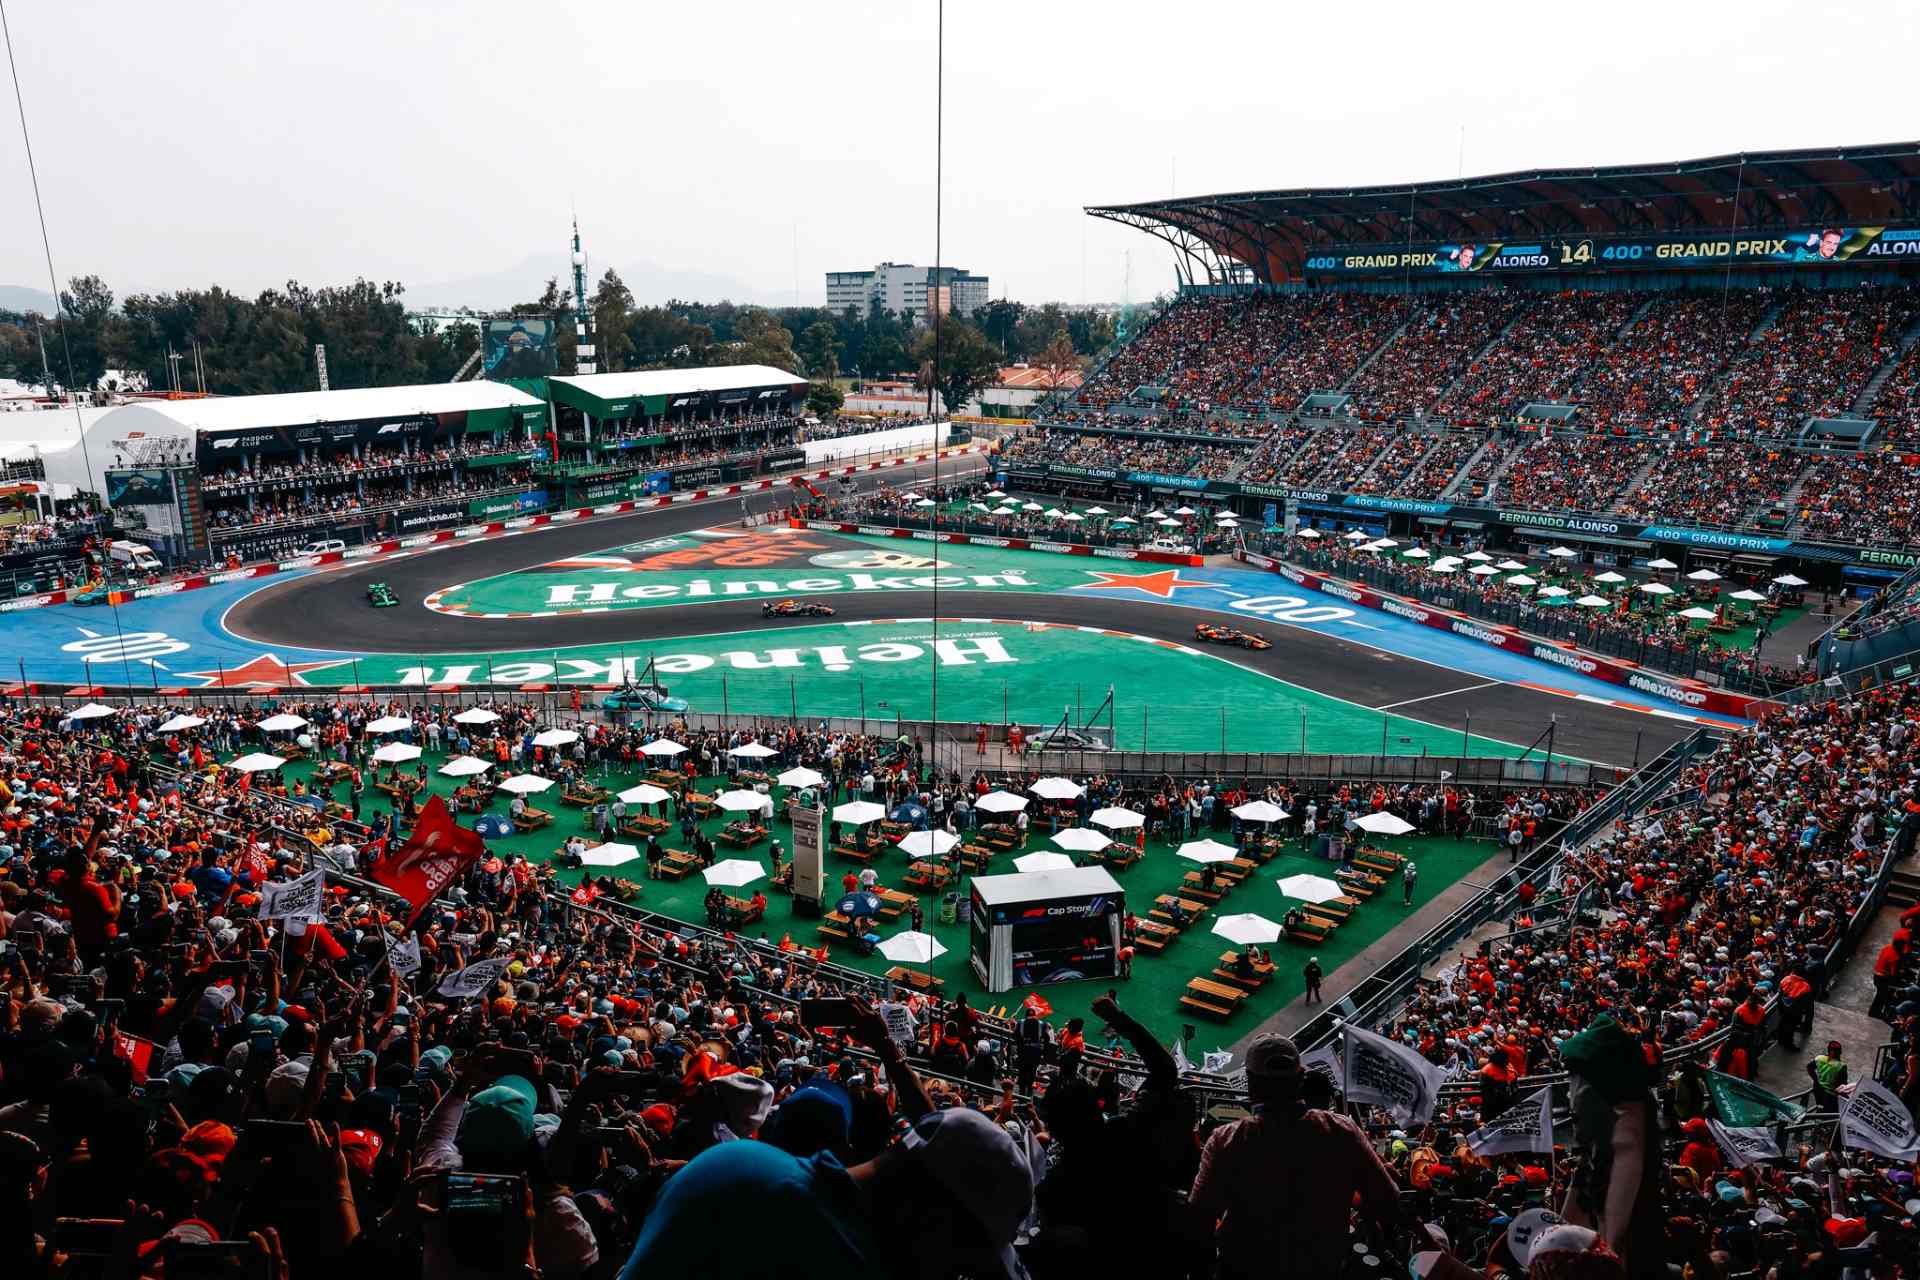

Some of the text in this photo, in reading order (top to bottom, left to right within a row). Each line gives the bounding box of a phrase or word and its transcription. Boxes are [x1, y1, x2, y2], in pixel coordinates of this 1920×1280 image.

[1561, 244, 1590, 262] 14
[1656, 242, 1730, 258] GRAND
[1735, 239, 1787, 255] PRIX
[1345, 255, 1398, 268] GRAND
[1401, 252, 1437, 266] PRIX
[1493, 255, 1549, 268] ALONSO
[1049, 464, 1117, 479] FERNANDO ALONSO
[220, 486, 264, 496] WHERE
[272, 477, 350, 491] ADRENALINE
[1241, 485, 1328, 502] FERNANDO ALONSO
[1381, 500, 1413, 511] GRAND
[1415, 503, 1437, 513] PRIX
[1499, 512, 1618, 533] FERNANDO ALONSO
[1691, 533, 1736, 547] GRAND
[1739, 537, 1770, 550] PRIX
[1859, 550, 1920, 567] FERNA
[1383, 600, 1429, 621] #MexicoGP
[1452, 620, 1506, 645] #MexicoGP
[396, 636, 1019, 685] Heineken
[1534, 646, 1597, 673] #MexicoGP
[1628, 673, 1707, 704] #MexicoGP
[1047, 907, 1065, 916] Cap
[1066, 904, 1091, 914] Store
